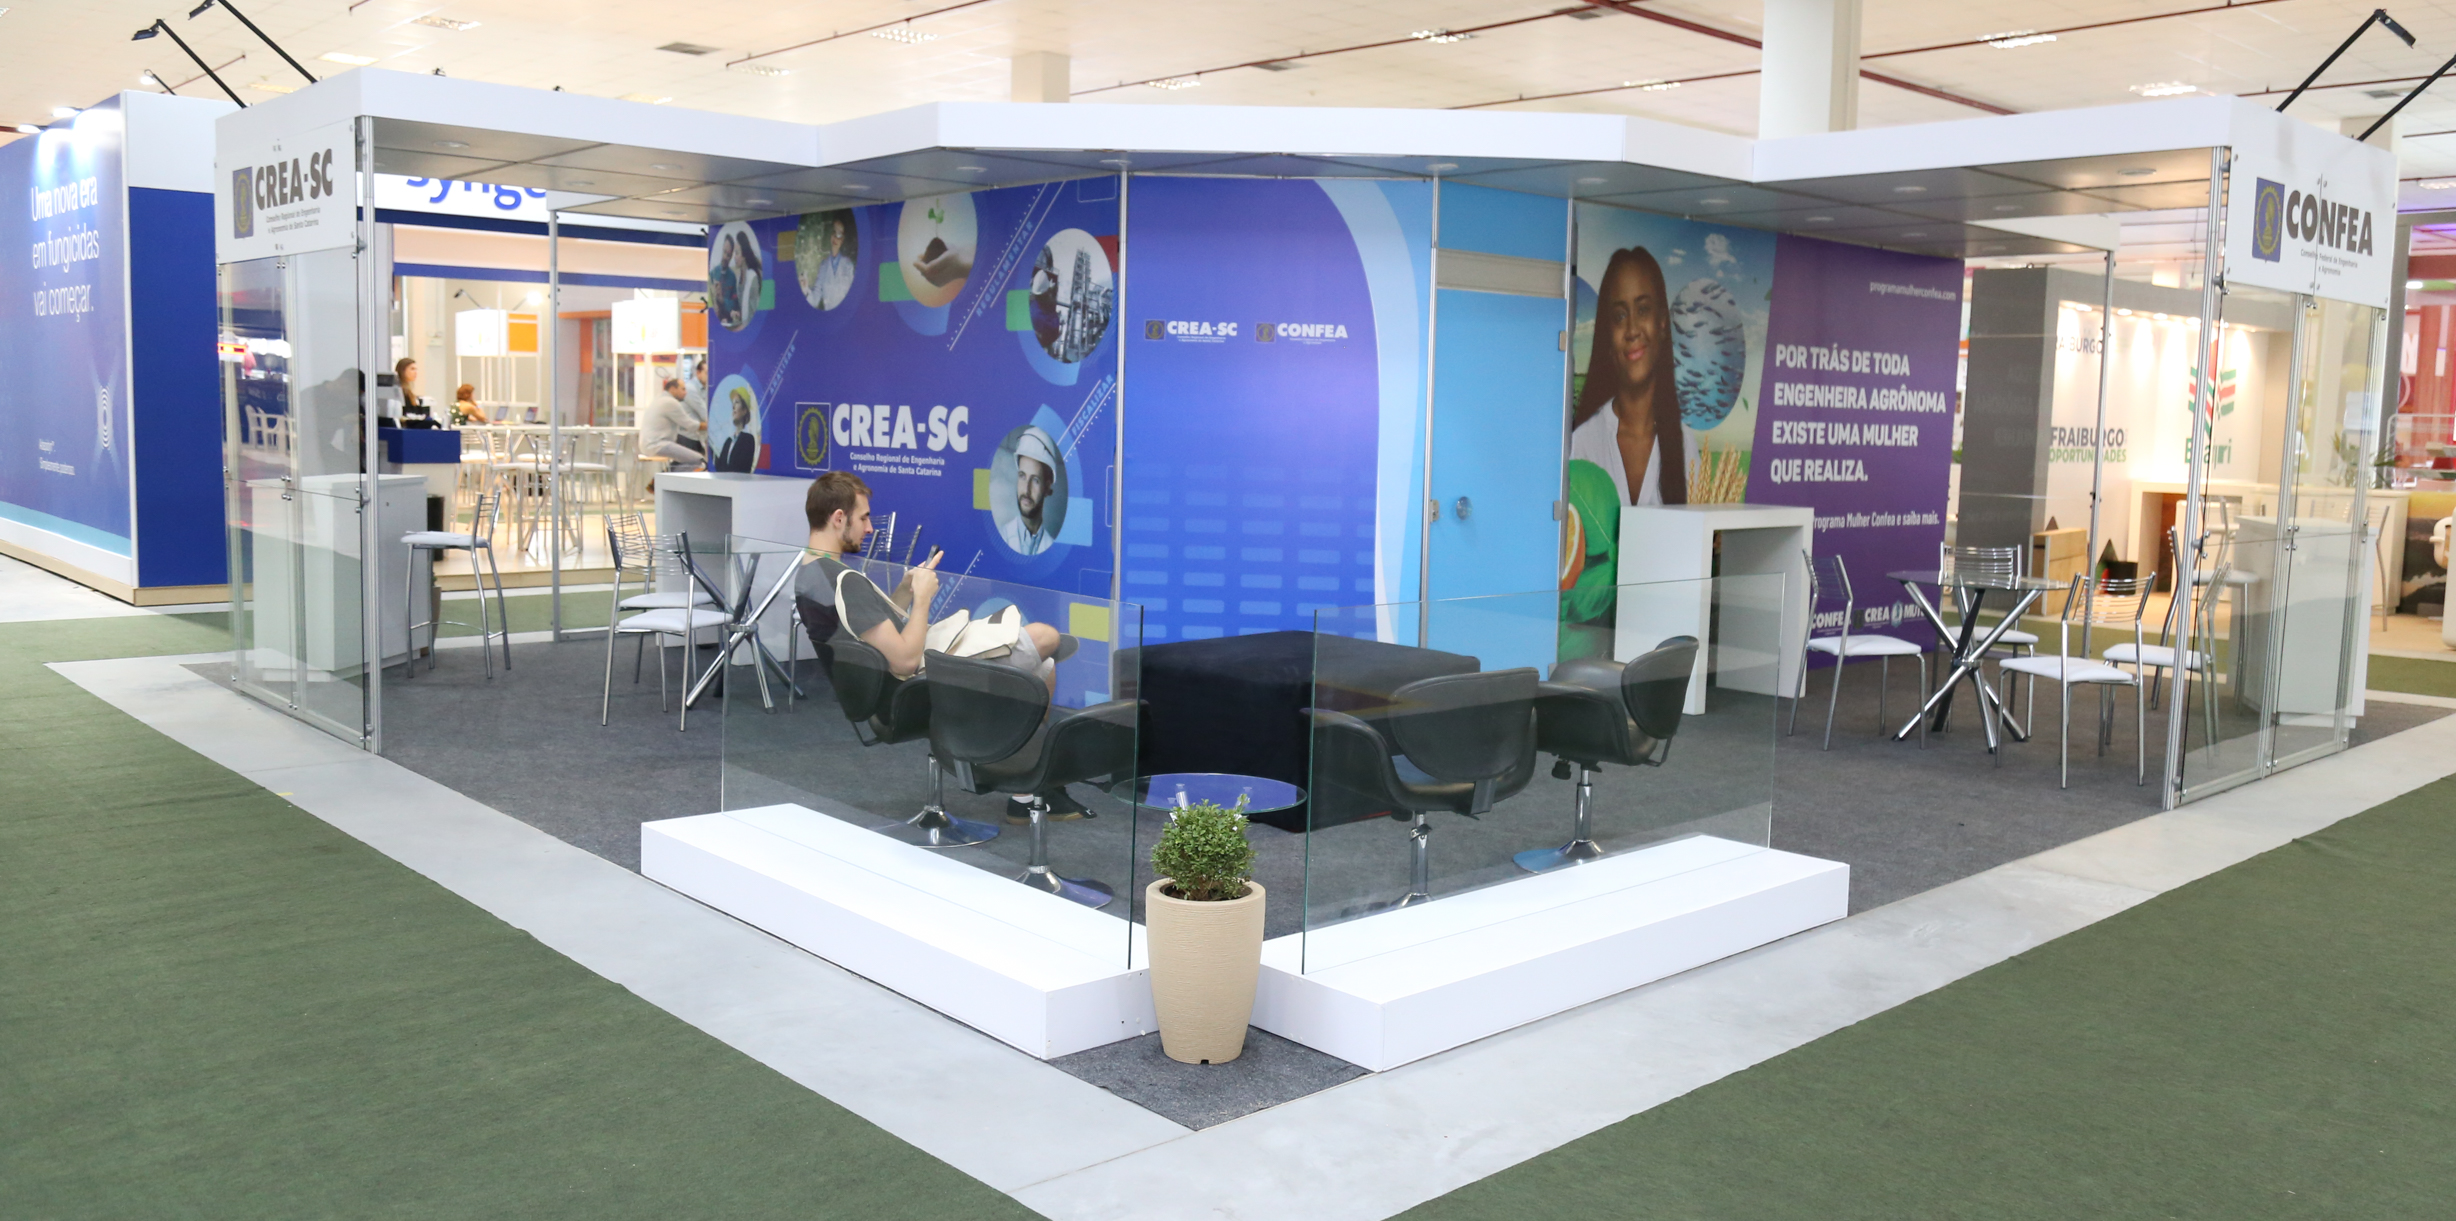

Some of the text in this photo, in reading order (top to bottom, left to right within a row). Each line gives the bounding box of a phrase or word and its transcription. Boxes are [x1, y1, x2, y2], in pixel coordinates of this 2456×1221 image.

[256, 149, 333, 211] CREA-SC
[31, 176, 98, 221] Uma nova era
[2286, 190, 2373, 257] CONFEA
[33, 222, 99, 273] em fungicidas
[33, 281, 94, 322] vai começar.
[1167, 320, 1238, 337] CREA-SC
[1277, 322, 1348, 339] CONFEA
[1775, 343, 1910, 376] POR TRÁS DE TODA
[1071, 374, 1114, 436] FISCALIZAR
[1773, 382, 1867, 410] ENGENHEIRA
[1869, 384, 1946, 413] AGRÔNOMA
[832, 403, 969, 453] CREA-SC
[1772, 420, 1919, 447] EXISTE UMA MULHER
[850, 452, 945, 466] Conselho Regional de Engenharia
[858, 464, 888, 474] Agronomia
[889, 465, 897, 474] de
[898, 466, 915, 475] Santa
[916, 467, 942, 477] Catarina
[1770, 458, 1868, 485] QUE REALIZA.
[1814, 510, 1940, 532] rograma Mulher Confea e saiba mais.
[1811, 610, 1851, 630] CONFE
[1864, 606, 1890, 623] CREA
